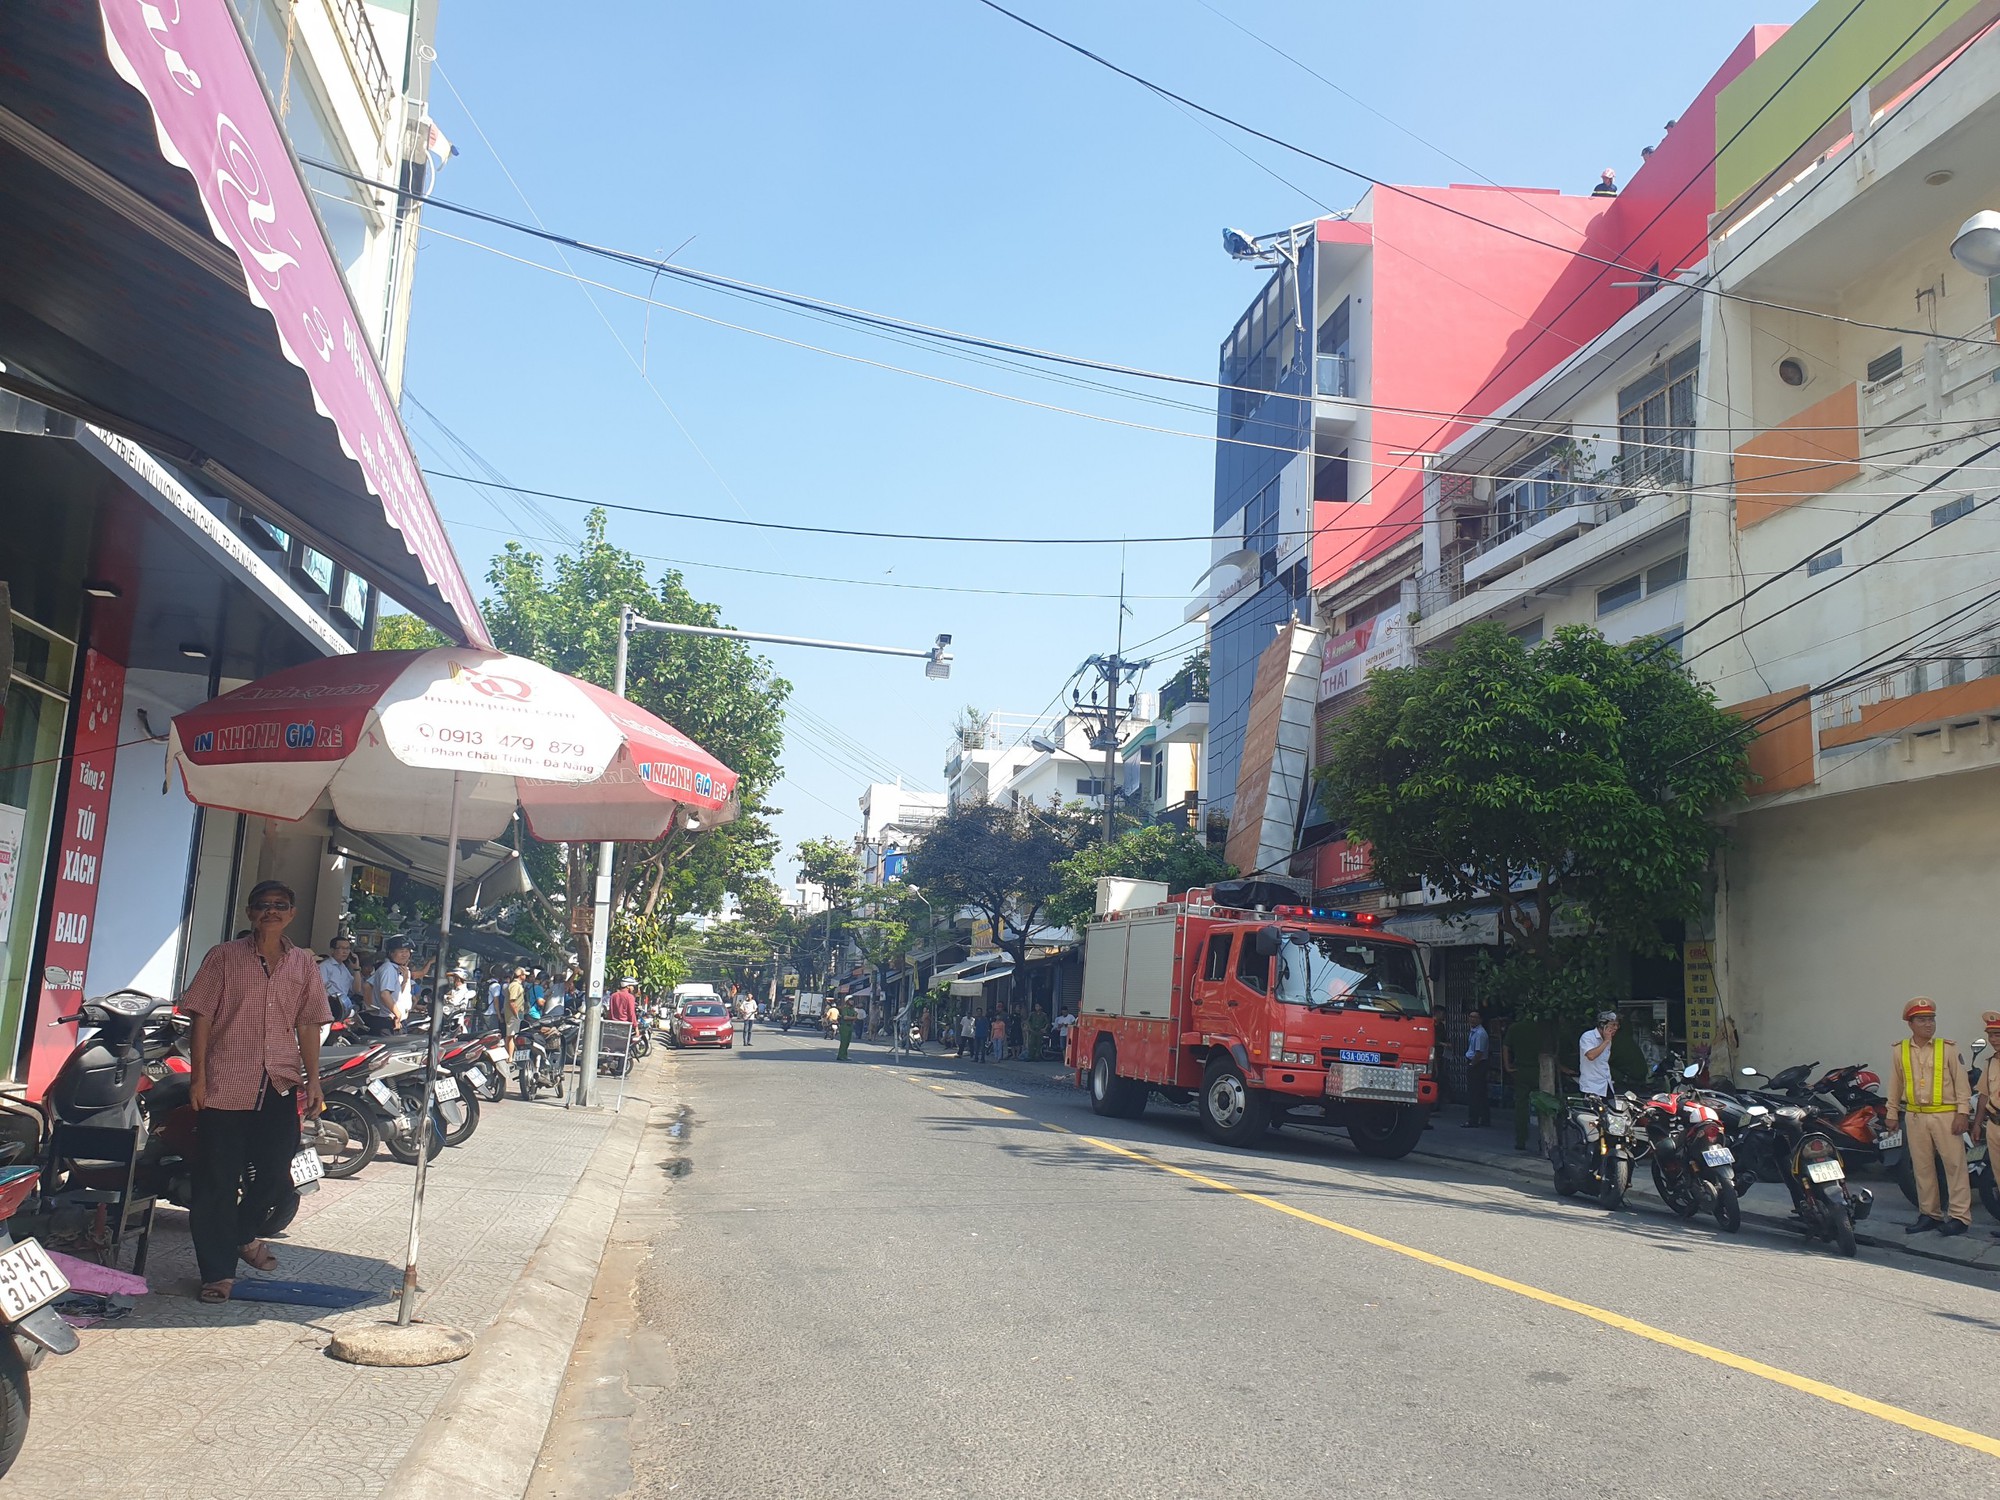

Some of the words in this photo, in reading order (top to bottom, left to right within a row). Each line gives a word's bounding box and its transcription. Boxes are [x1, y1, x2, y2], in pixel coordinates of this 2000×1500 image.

[1322, 667, 1348, 695] THÁI
[194, 731, 213, 752] IN
[217, 722, 281, 751] NHANH
[285, 719, 316, 749] GIÁ
[317, 724, 343, 748] RẺ
[439, 728, 483, 745] 0913
[498, 735, 534, 751] 479
[549, 741, 585, 757] 879
[431, 747, 463, 758] Phan
[98, 773, 106, 791] 2
[639, 762, 651, 782] IN
[653, 762, 693, 792] NHANH
[694, 771, 713, 798] GIÁ
[77, 805, 97, 842] TÚI
[62, 846, 97, 885] XÁCH
[1339, 846, 1364, 873] Thái
[55, 911, 88, 945] BALO
[294, 1164, 319, 1183] 3139
[8, 1270, 59, 1311] 3412
